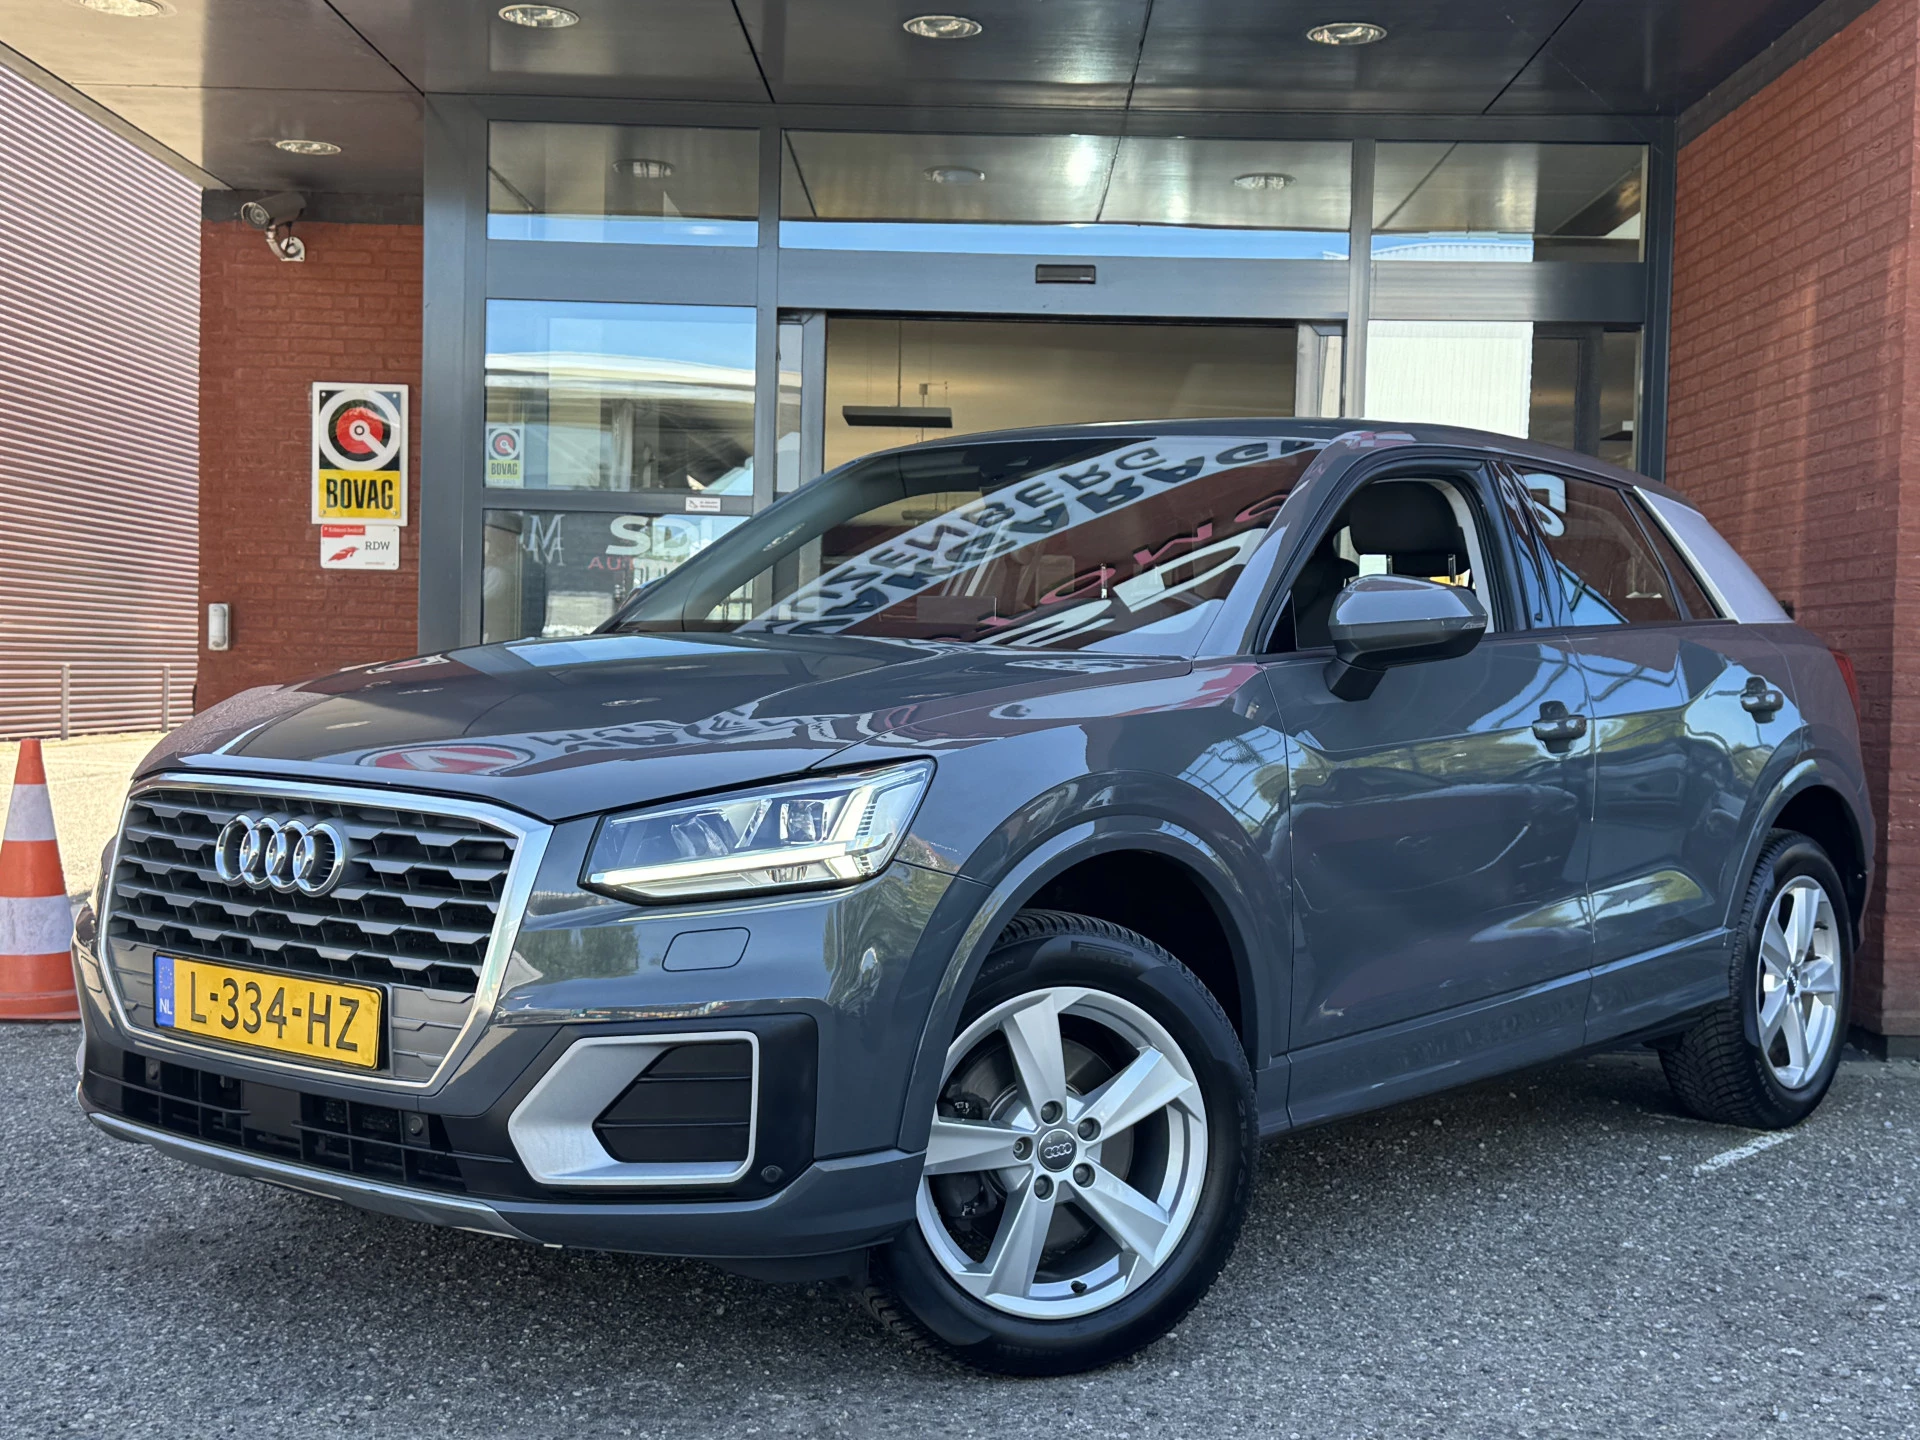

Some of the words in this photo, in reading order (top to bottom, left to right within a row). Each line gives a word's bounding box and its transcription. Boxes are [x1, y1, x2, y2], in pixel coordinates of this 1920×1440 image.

[491, 463, 518, 475] BOVAG
[326, 479, 394, 510] BOVAG
[365, 541, 390, 551] RDW
[159, 998, 174, 1015] NL
[191, 971, 358, 1052] L-334-HZ
